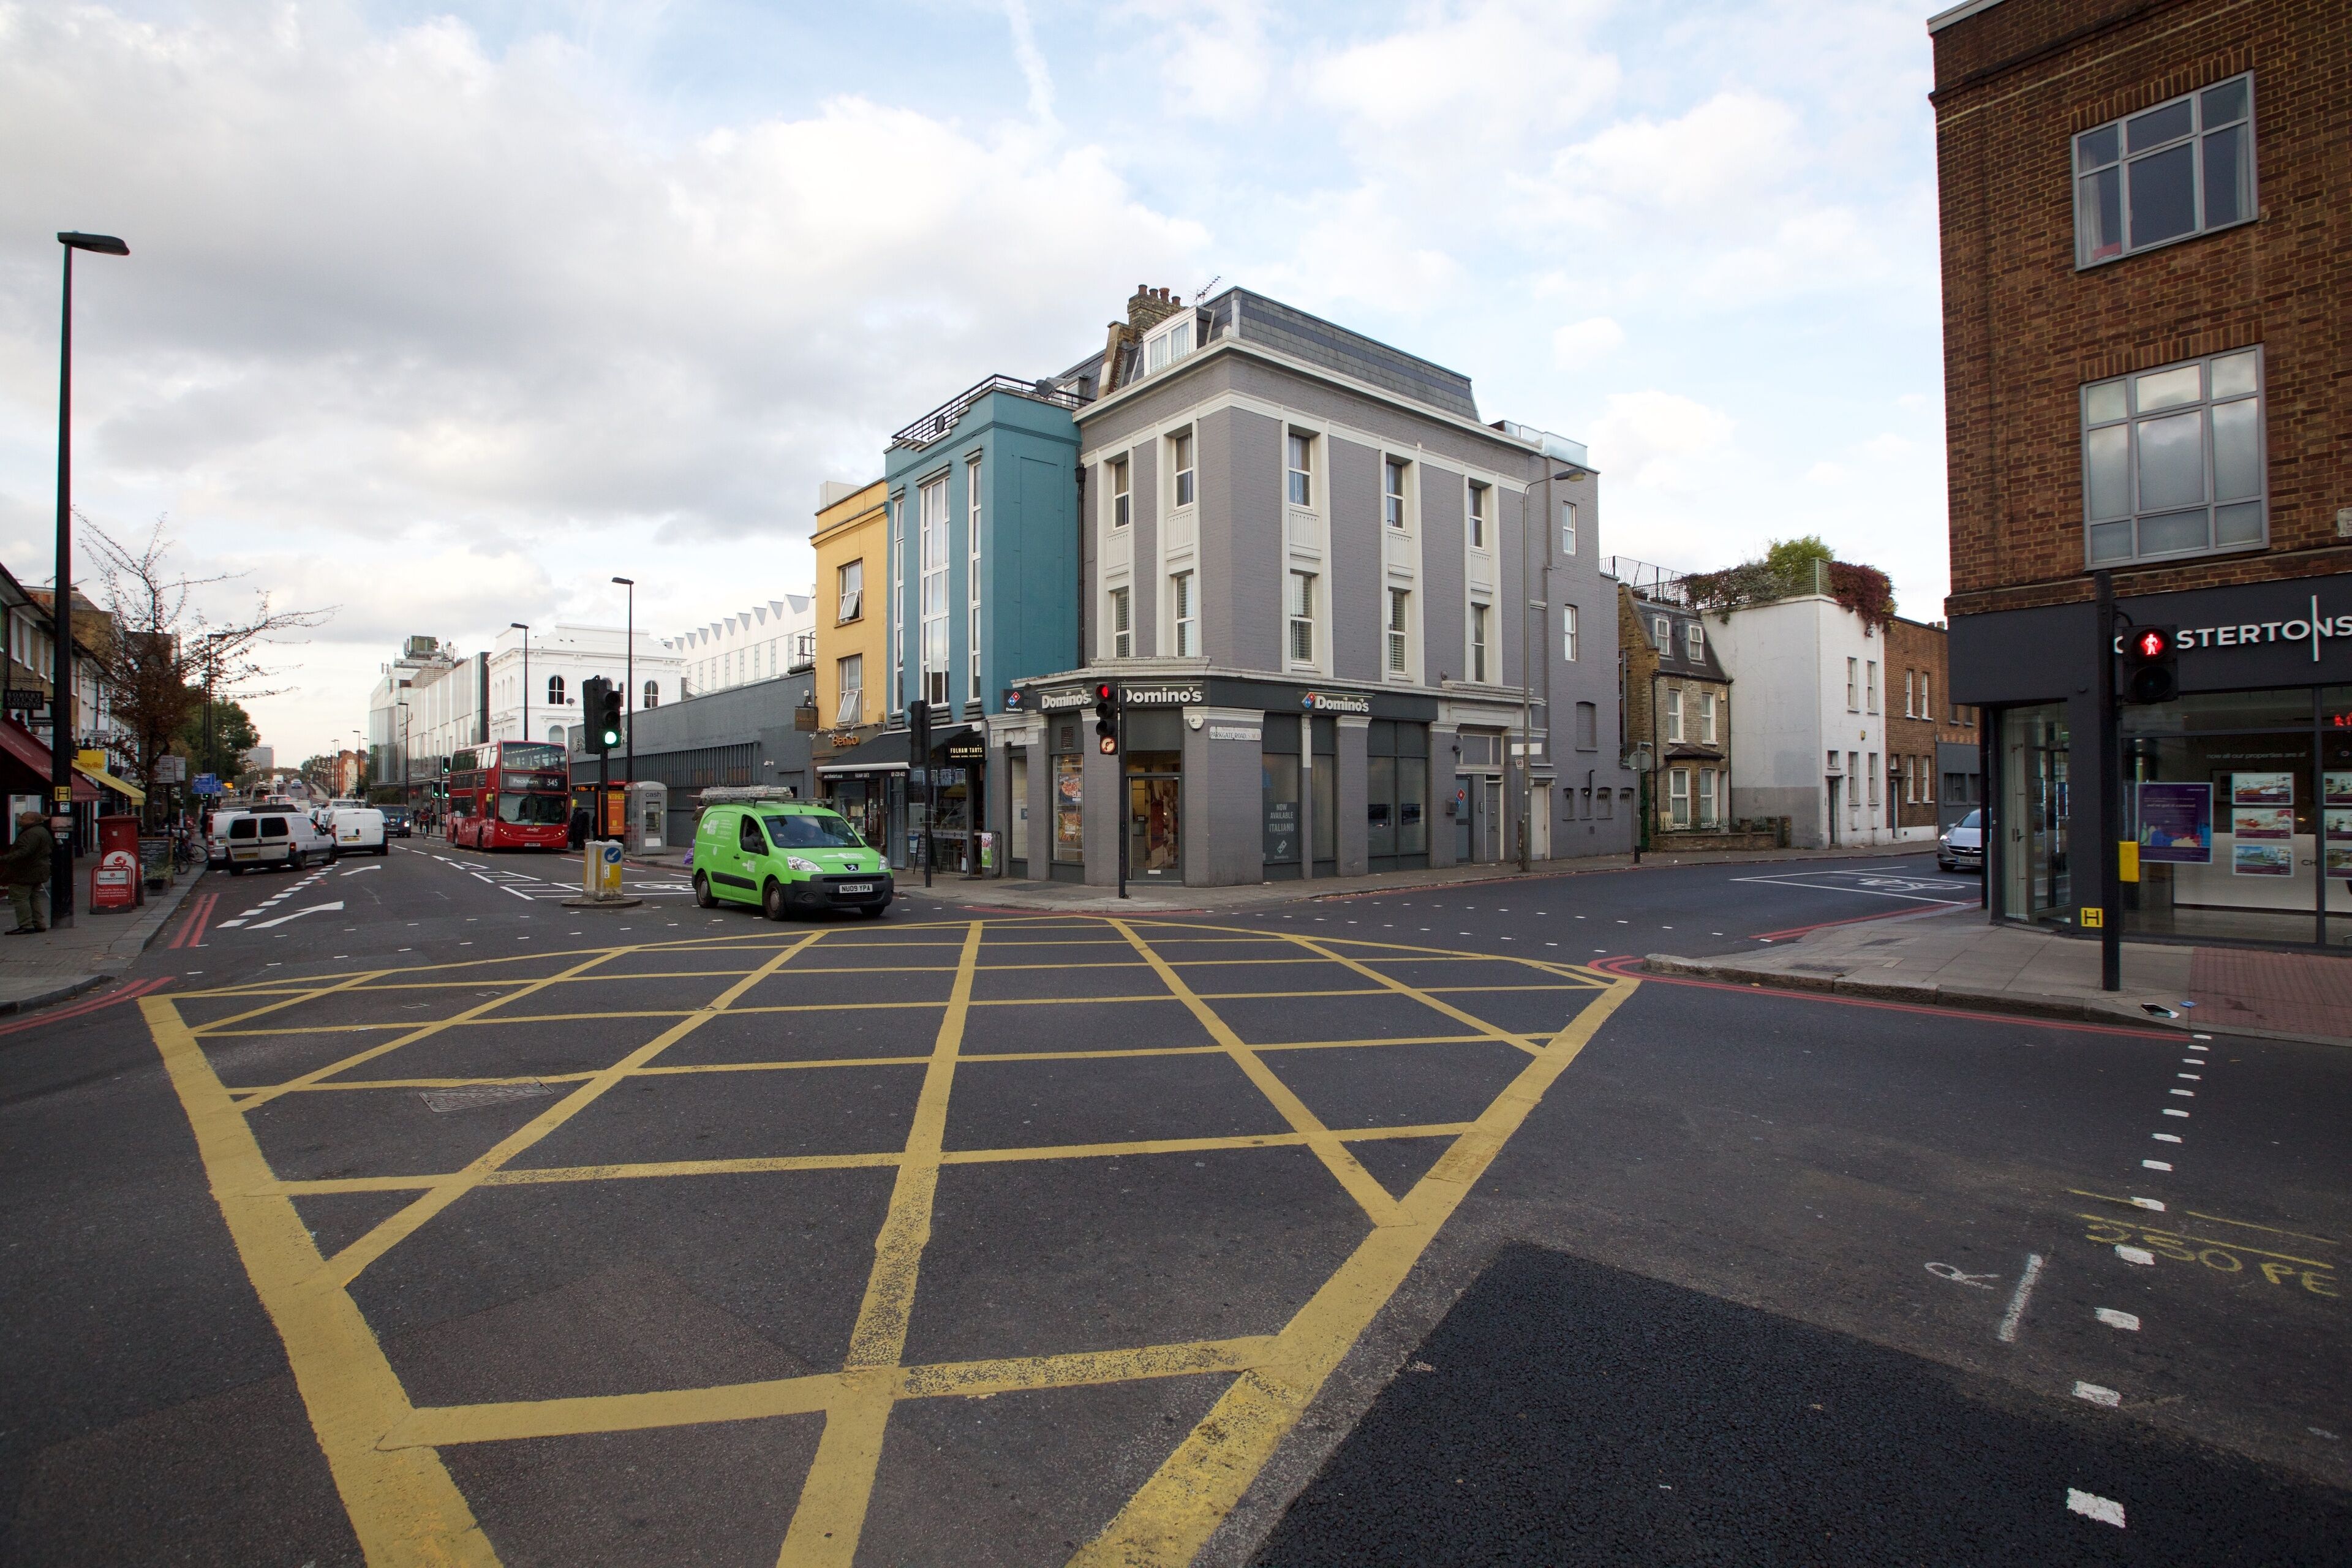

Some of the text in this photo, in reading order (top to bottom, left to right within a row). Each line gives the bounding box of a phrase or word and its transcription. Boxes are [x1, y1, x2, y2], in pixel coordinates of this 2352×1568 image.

[1042, 689, 1091, 709] Domino's
[1315, 696, 1369, 712] Domino's
[832, 735, 859, 746] Bento
[1269, 823, 1294, 832] ITALIANO
[2084, 910, 2099, 925] H
